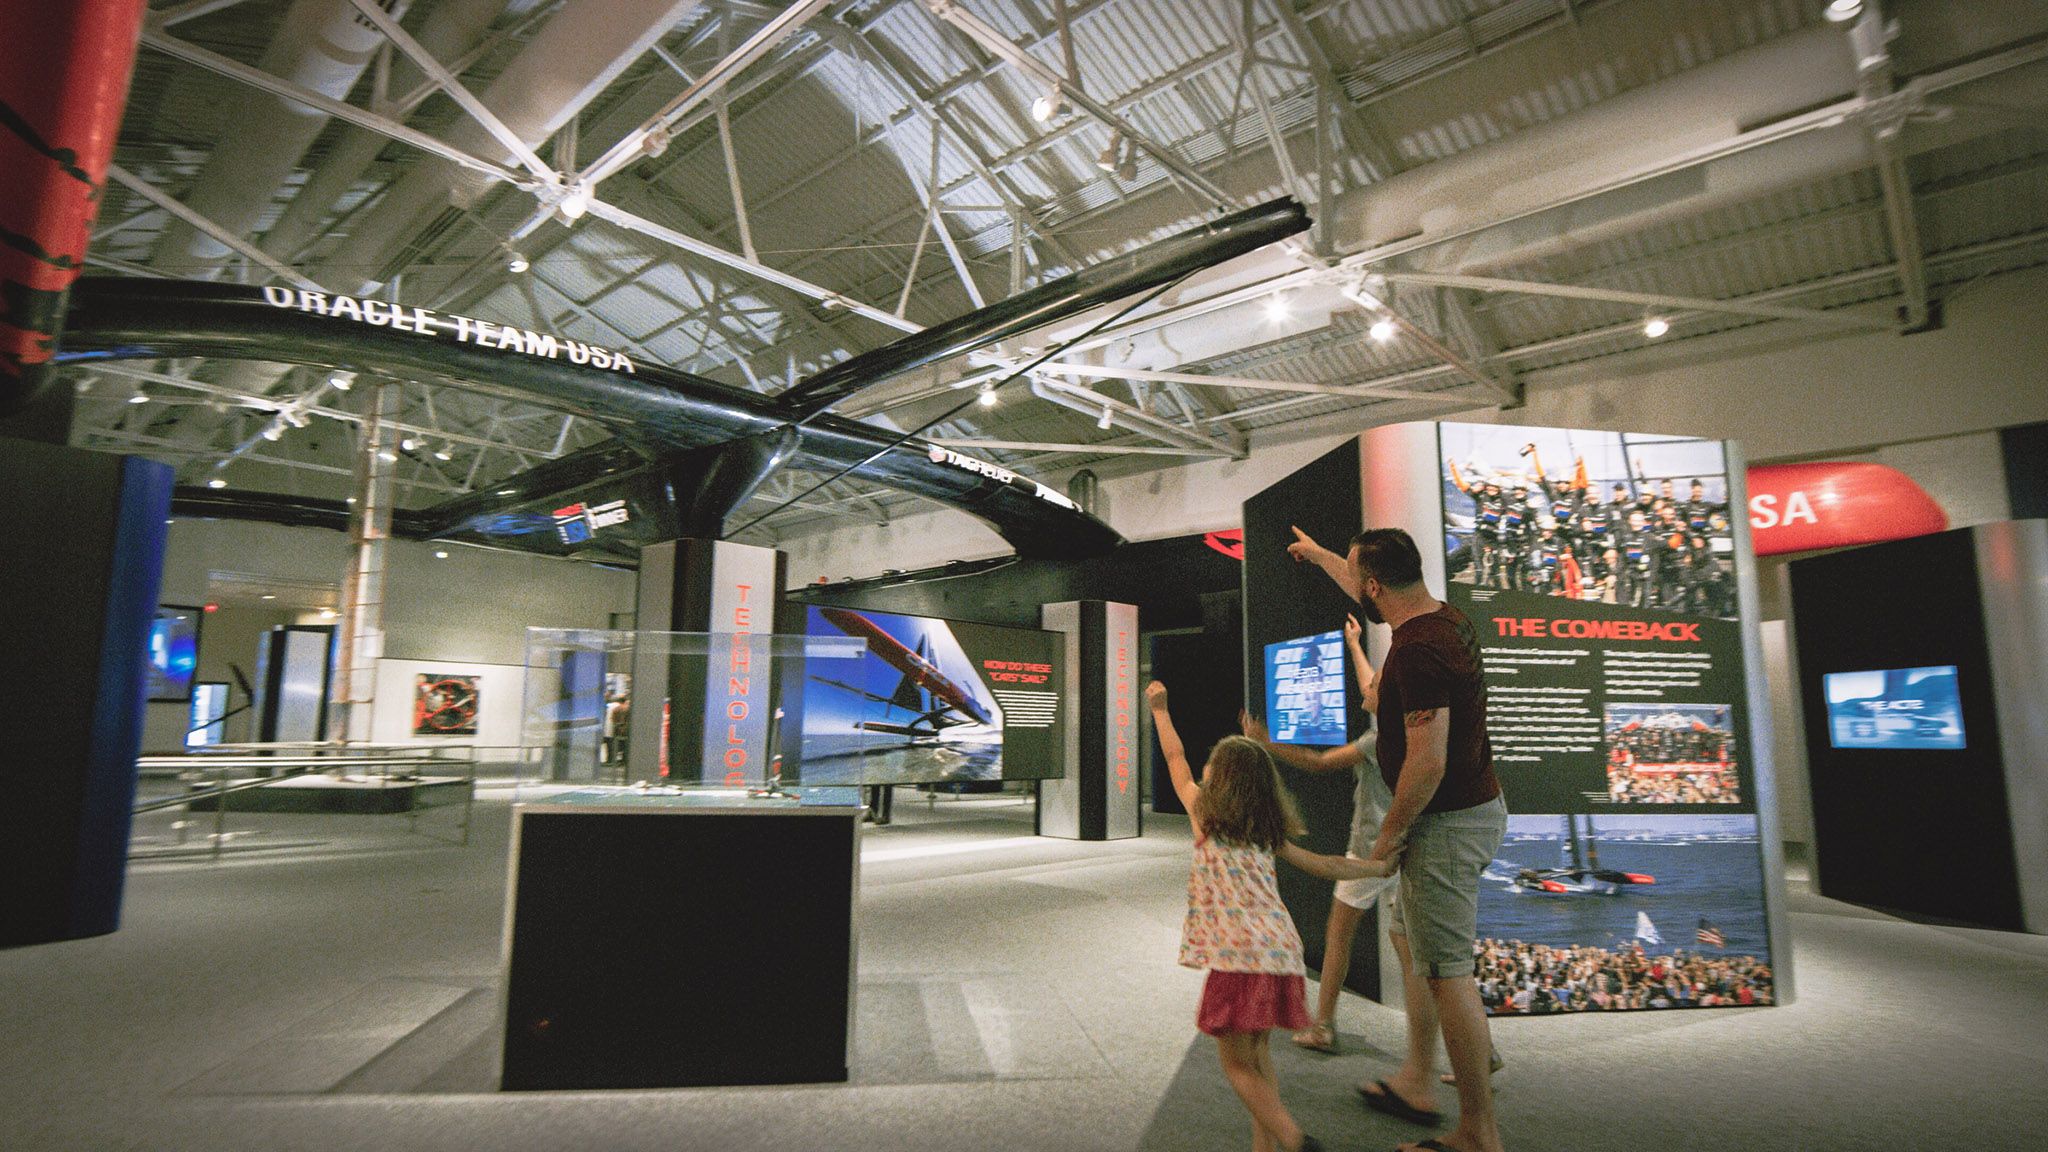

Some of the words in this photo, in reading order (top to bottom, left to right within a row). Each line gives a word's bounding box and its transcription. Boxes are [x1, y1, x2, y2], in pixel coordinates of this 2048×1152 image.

[265, 286, 438, 336] ORACLE
[449, 315, 558, 359] TEAM
[565, 340, 636, 373] USA
[1749, 491, 1819, 529] SA
[1492, 617, 1548, 638] THE
[1550, 619, 1702, 642] COMEBACK
